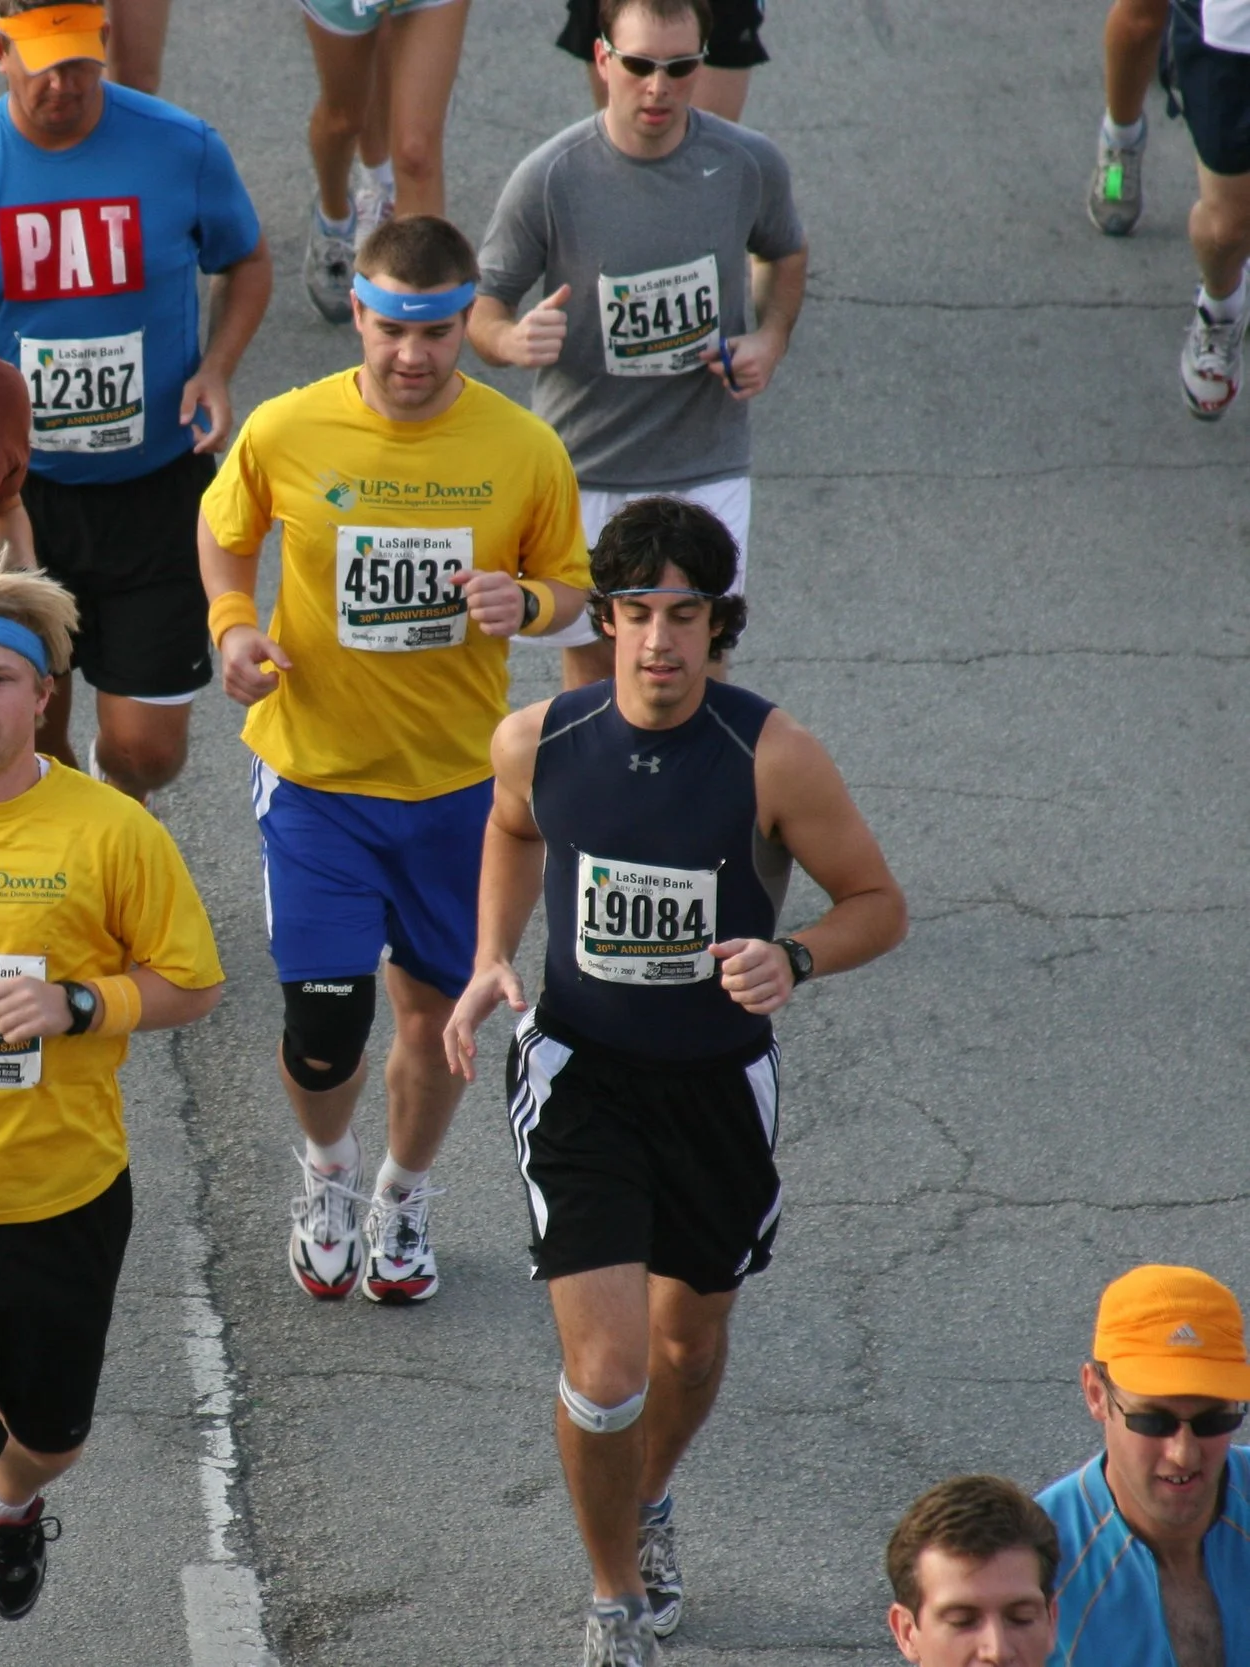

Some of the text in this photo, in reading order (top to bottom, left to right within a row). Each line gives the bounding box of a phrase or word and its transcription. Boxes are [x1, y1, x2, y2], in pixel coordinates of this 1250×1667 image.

[16, 205, 130, 291] PAT
[635, 271, 700, 293] LaSalle Bank
[607, 285, 712, 338] 25416
[58, 345, 125, 360] LaSalle Bank
[30, 362, 135, 410] 12367
[67, 405, 137, 425] ANNIVERSARY
[359, 479, 494, 499] UPS for DownS
[379, 537, 453, 550] LaSalle Bank
[344, 558, 463, 605] 45033
[359, 603, 461, 624] 30th ANNIVERSARY
[616, 871, 694, 890] LaSalle Bank
[584, 886, 707, 941] 19084
[595, 941, 705, 955] 30th ANNIVERSARY
